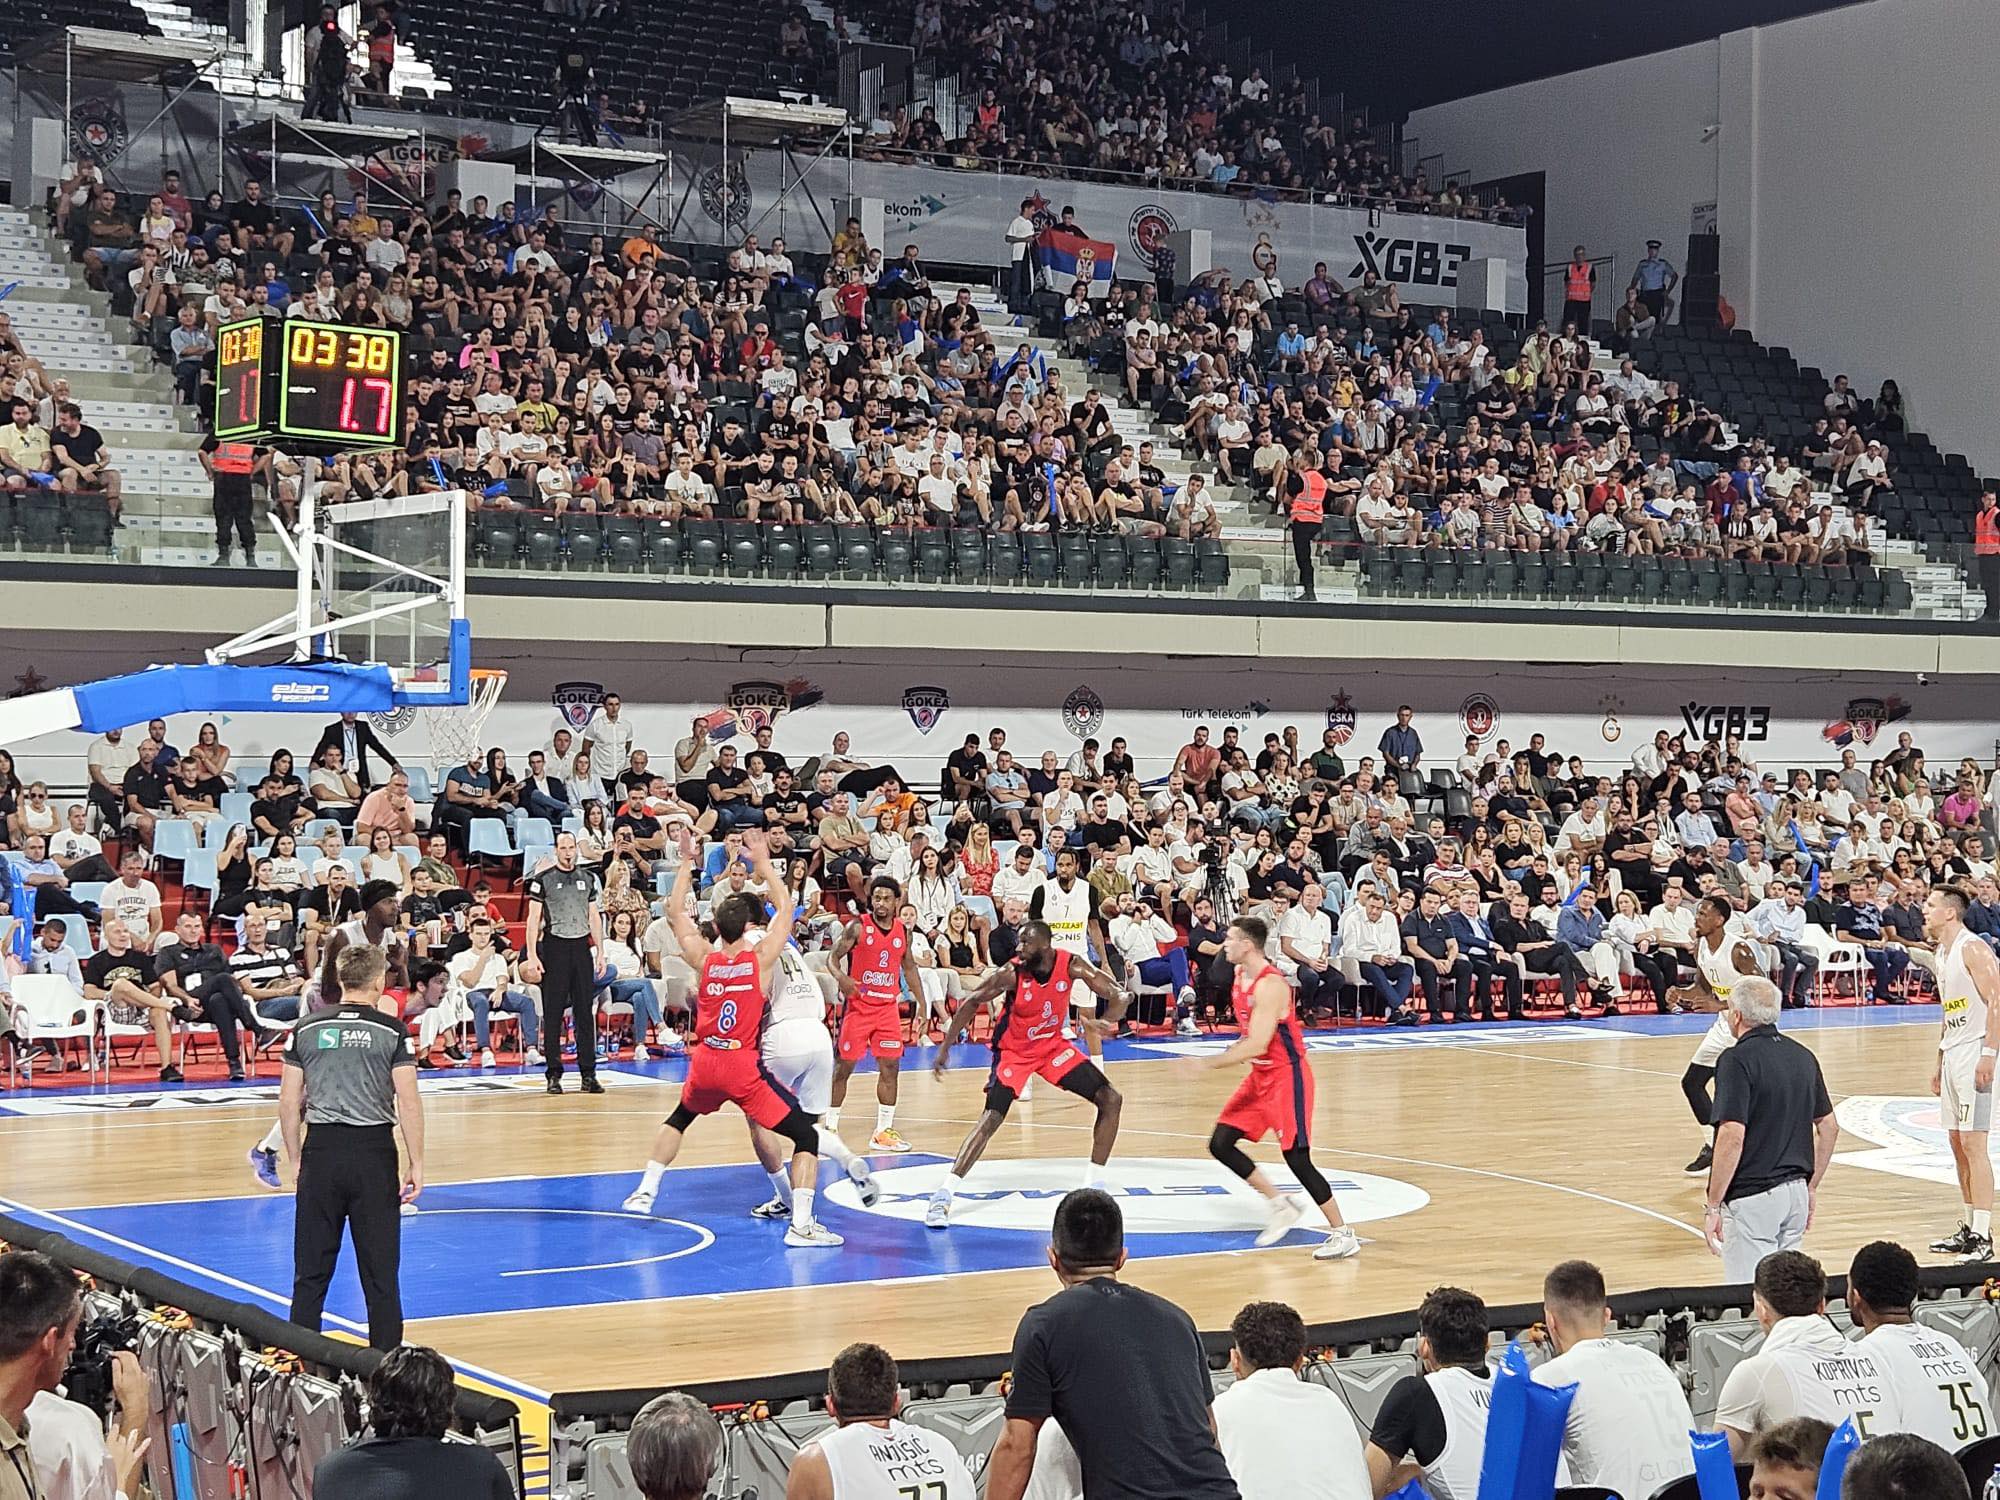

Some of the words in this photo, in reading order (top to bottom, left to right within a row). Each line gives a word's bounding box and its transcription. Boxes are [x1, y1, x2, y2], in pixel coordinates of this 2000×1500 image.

[884, 203, 922, 217] ekom
[1347, 231, 1471, 287] XGB3
[272, 682, 330, 694] elan
[728, 693, 788, 708] IGOKEA
[901, 697, 950, 709] IGOKEA
[1180, 708, 1204, 719] Türk
[1206, 708, 1251, 720] Telekom
[1329, 712, 1354, 723] CSKA
[1679, 701, 1771, 741] XGB3
[1064, 904, 1070, 919] 7
[1065, 933, 1081, 941] NIS
[879, 950, 889, 968] 2
[862, 970, 895, 987] CSKA
[1709, 969, 1721, 983] 21
[717, 1000, 738, 1034] 8
[1042, 1001, 1052, 1019] 3
[1947, 1015, 1968, 1030] NIS
[342, 1030, 372, 1041] SAVA
[1922, 1359, 1968, 1379] mts
[1832, 1383, 1882, 1406] mts
[1938, 1381, 1988, 1441] 35
[888, 1459, 945, 1481] mts
